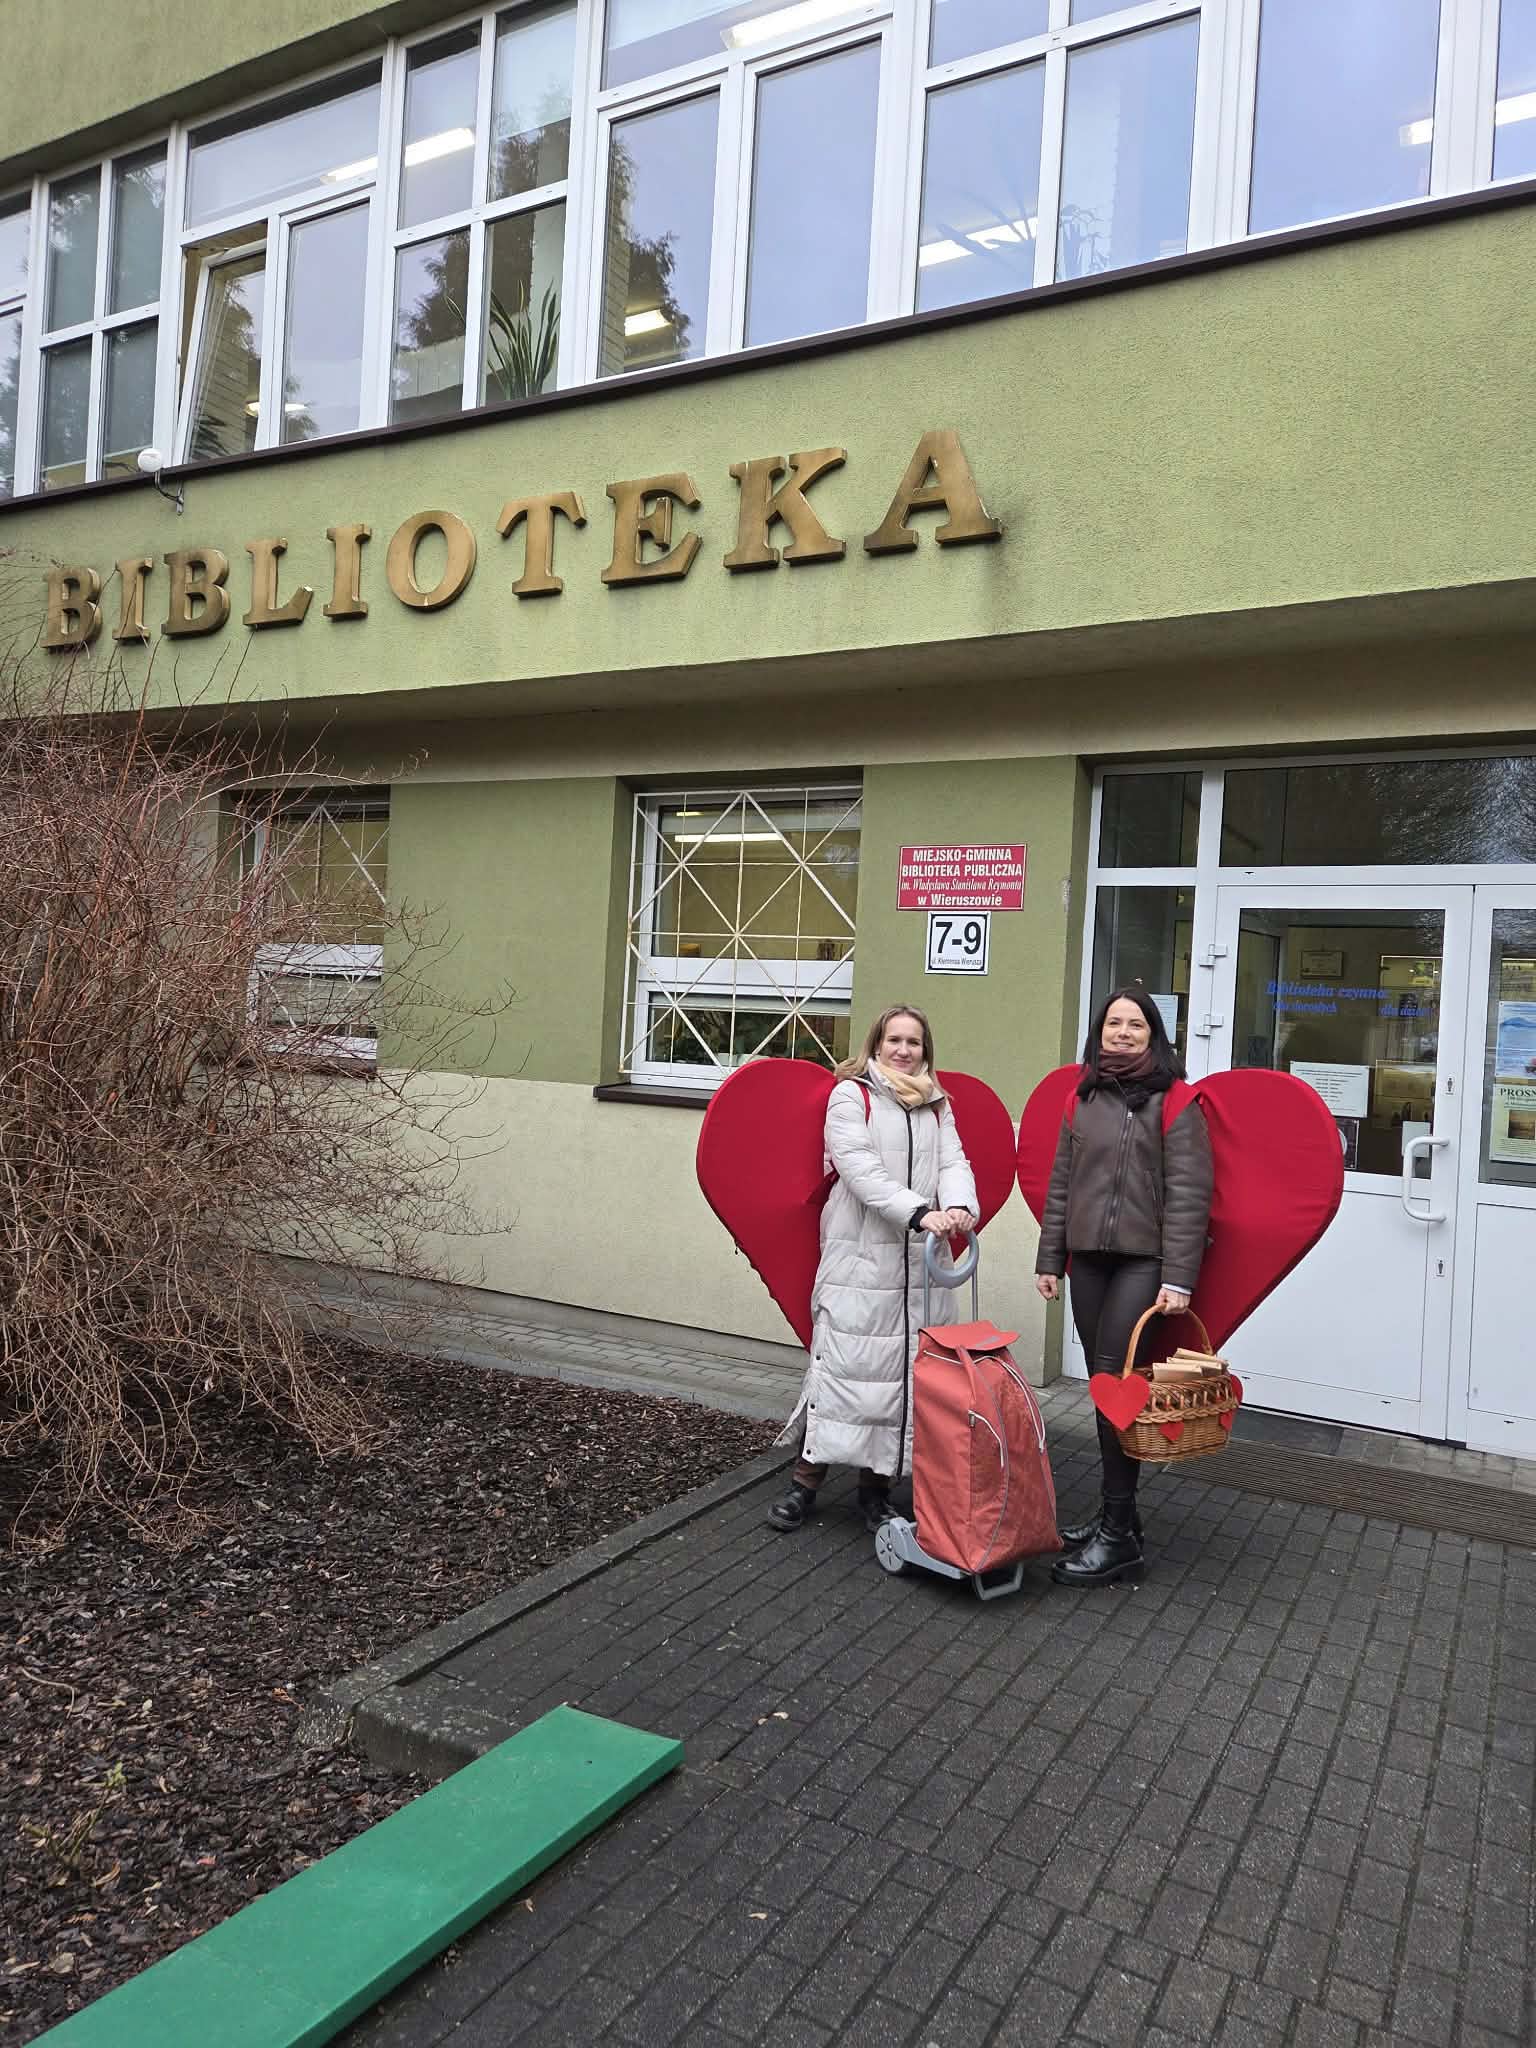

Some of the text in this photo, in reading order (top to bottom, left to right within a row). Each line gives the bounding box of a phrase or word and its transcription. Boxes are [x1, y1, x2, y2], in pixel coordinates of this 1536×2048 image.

[41, 430, 1003, 652] BIBLIOTEKA
[913, 849, 1011, 862] MIEJSKO-GMINNA
[902, 864, 1022, 877] BIBLIOTEKA PUBLICZNA
[918, 894, 1002, 905] w Wieruszowie
[935, 922, 981, 954] 7-9
